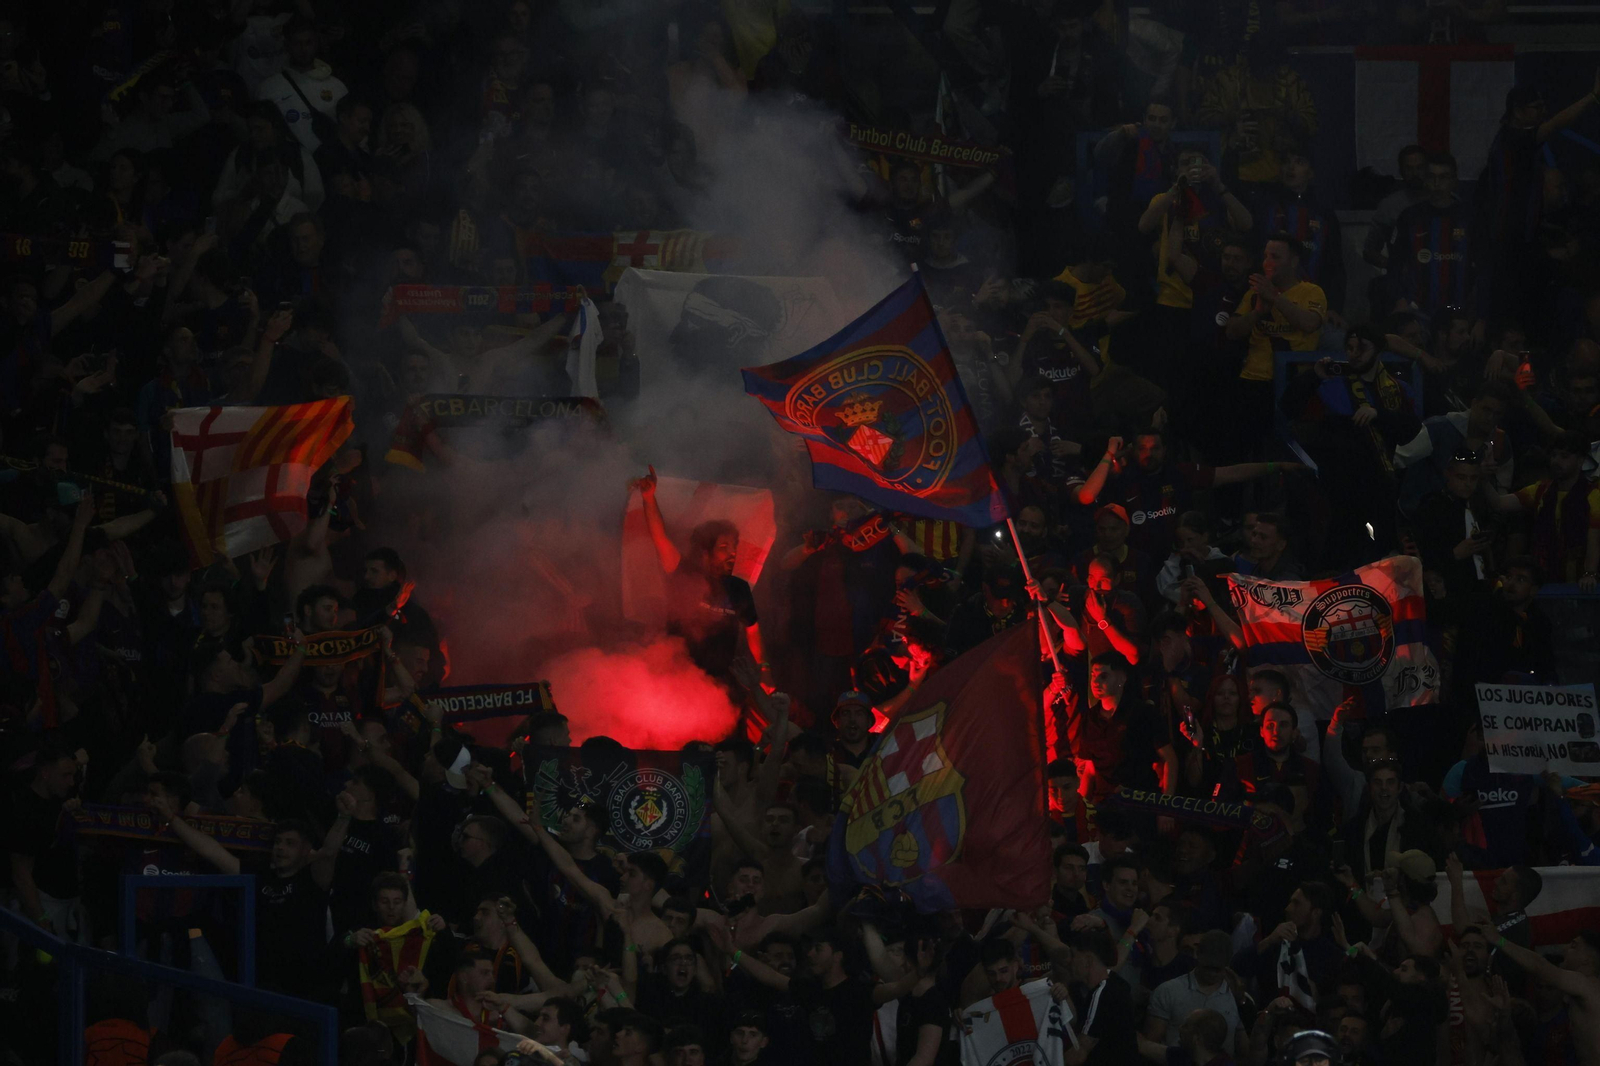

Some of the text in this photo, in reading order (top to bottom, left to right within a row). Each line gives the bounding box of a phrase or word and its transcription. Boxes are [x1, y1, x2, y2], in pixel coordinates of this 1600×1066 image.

[850, 124, 1000, 164] Futbol Club Barcelona
[1434, 252, 1463, 262] Spotify
[419, 397, 583, 418] FCBARCELONA
[1147, 506, 1176, 519] Spotify
[1315, 588, 1371, 612] Supporters
[516, 689, 533, 705] FC
[1477, 688, 1594, 708] LOS JUGADORES
[308, 711, 352, 724] QATAR
[1483, 715, 1577, 732] SE COMPRAN
[1486, 743, 1499, 756] LA
[1476, 787, 1519, 802] beko
[611, 774, 685, 841] FOOT-BALL CLUB BARCELONA
[631, 835, 653, 849] 1899
[1010, 1045, 1032, 1058] 2022
